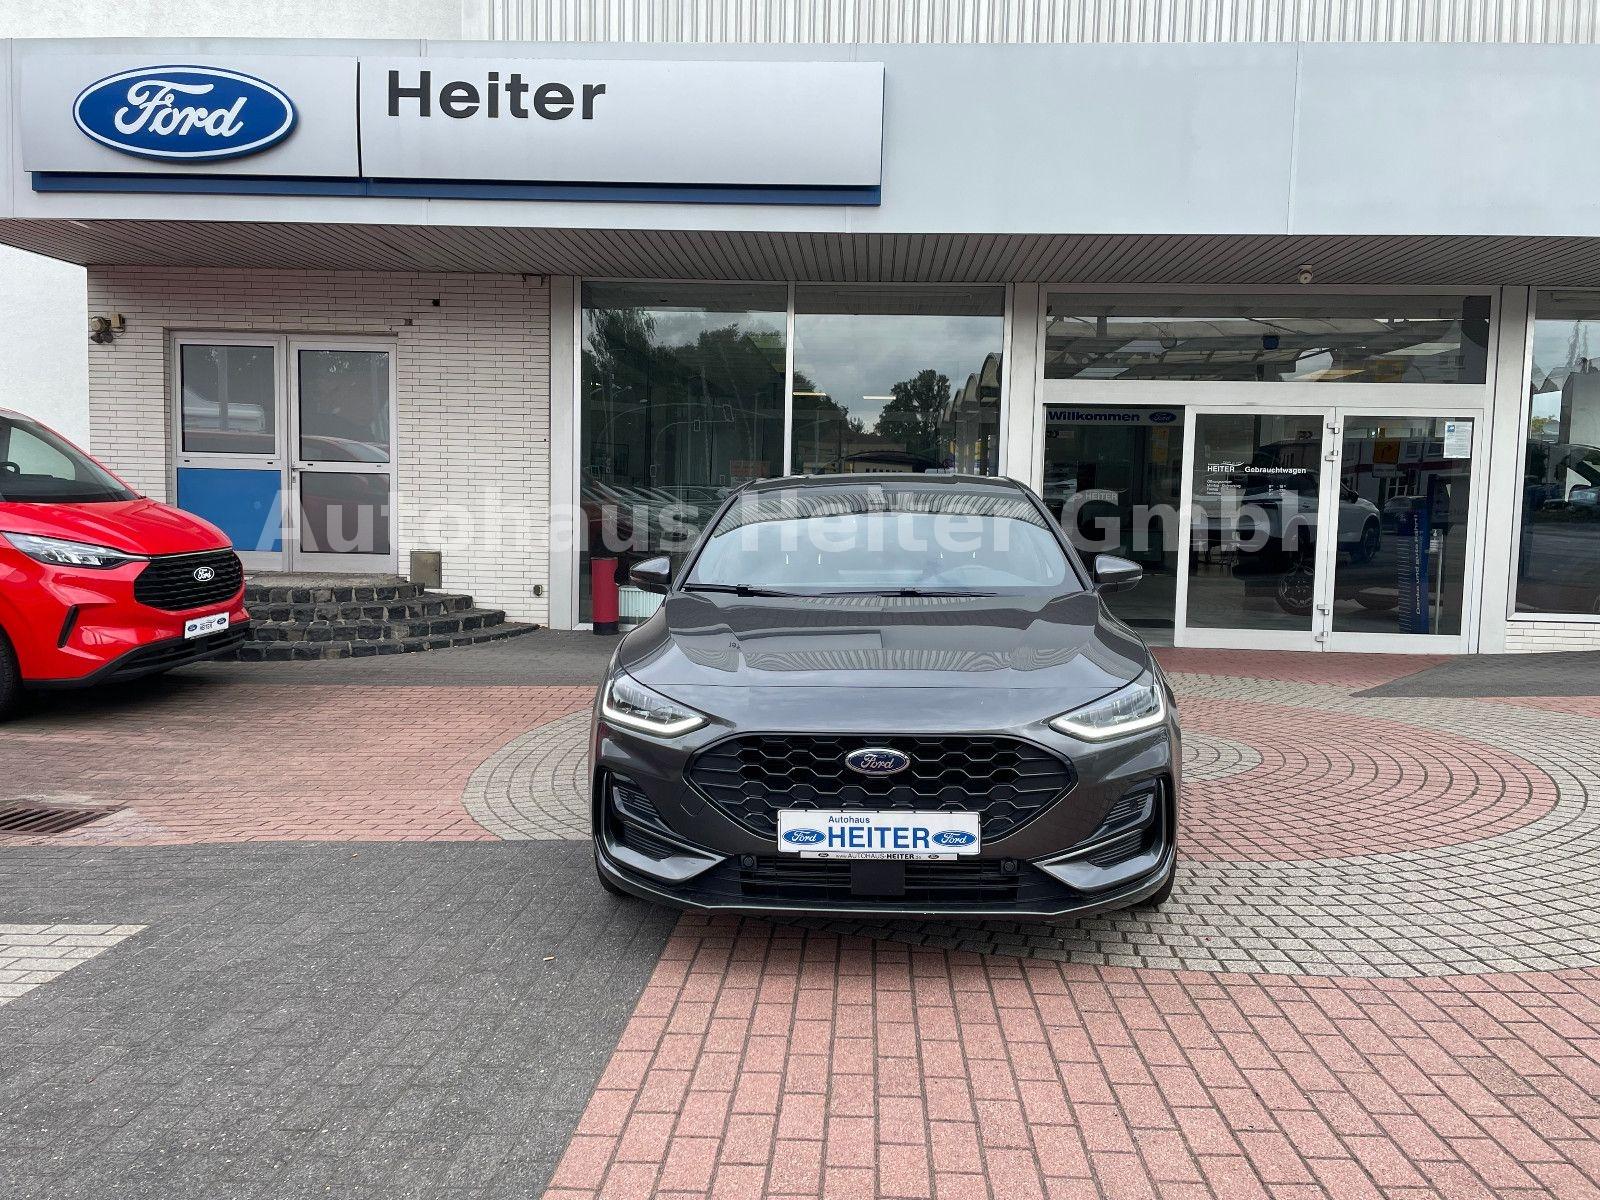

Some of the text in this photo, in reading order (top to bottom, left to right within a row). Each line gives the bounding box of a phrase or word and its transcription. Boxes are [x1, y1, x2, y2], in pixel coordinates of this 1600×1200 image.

[114, 69, 607, 138] Ford Heiter
[1048, 410, 1141, 422] Willkommen
[1207, 465, 1307, 475] HEITER Gebrauchtwagen
[1085, 492, 1118, 500] HEITER
[197, 568, 212, 580] Ford
[860, 753, 895, 769] Ford
[828, 815, 871, 824] Autohaus
[791, 826, 968, 849] Ford HEITER Ford
